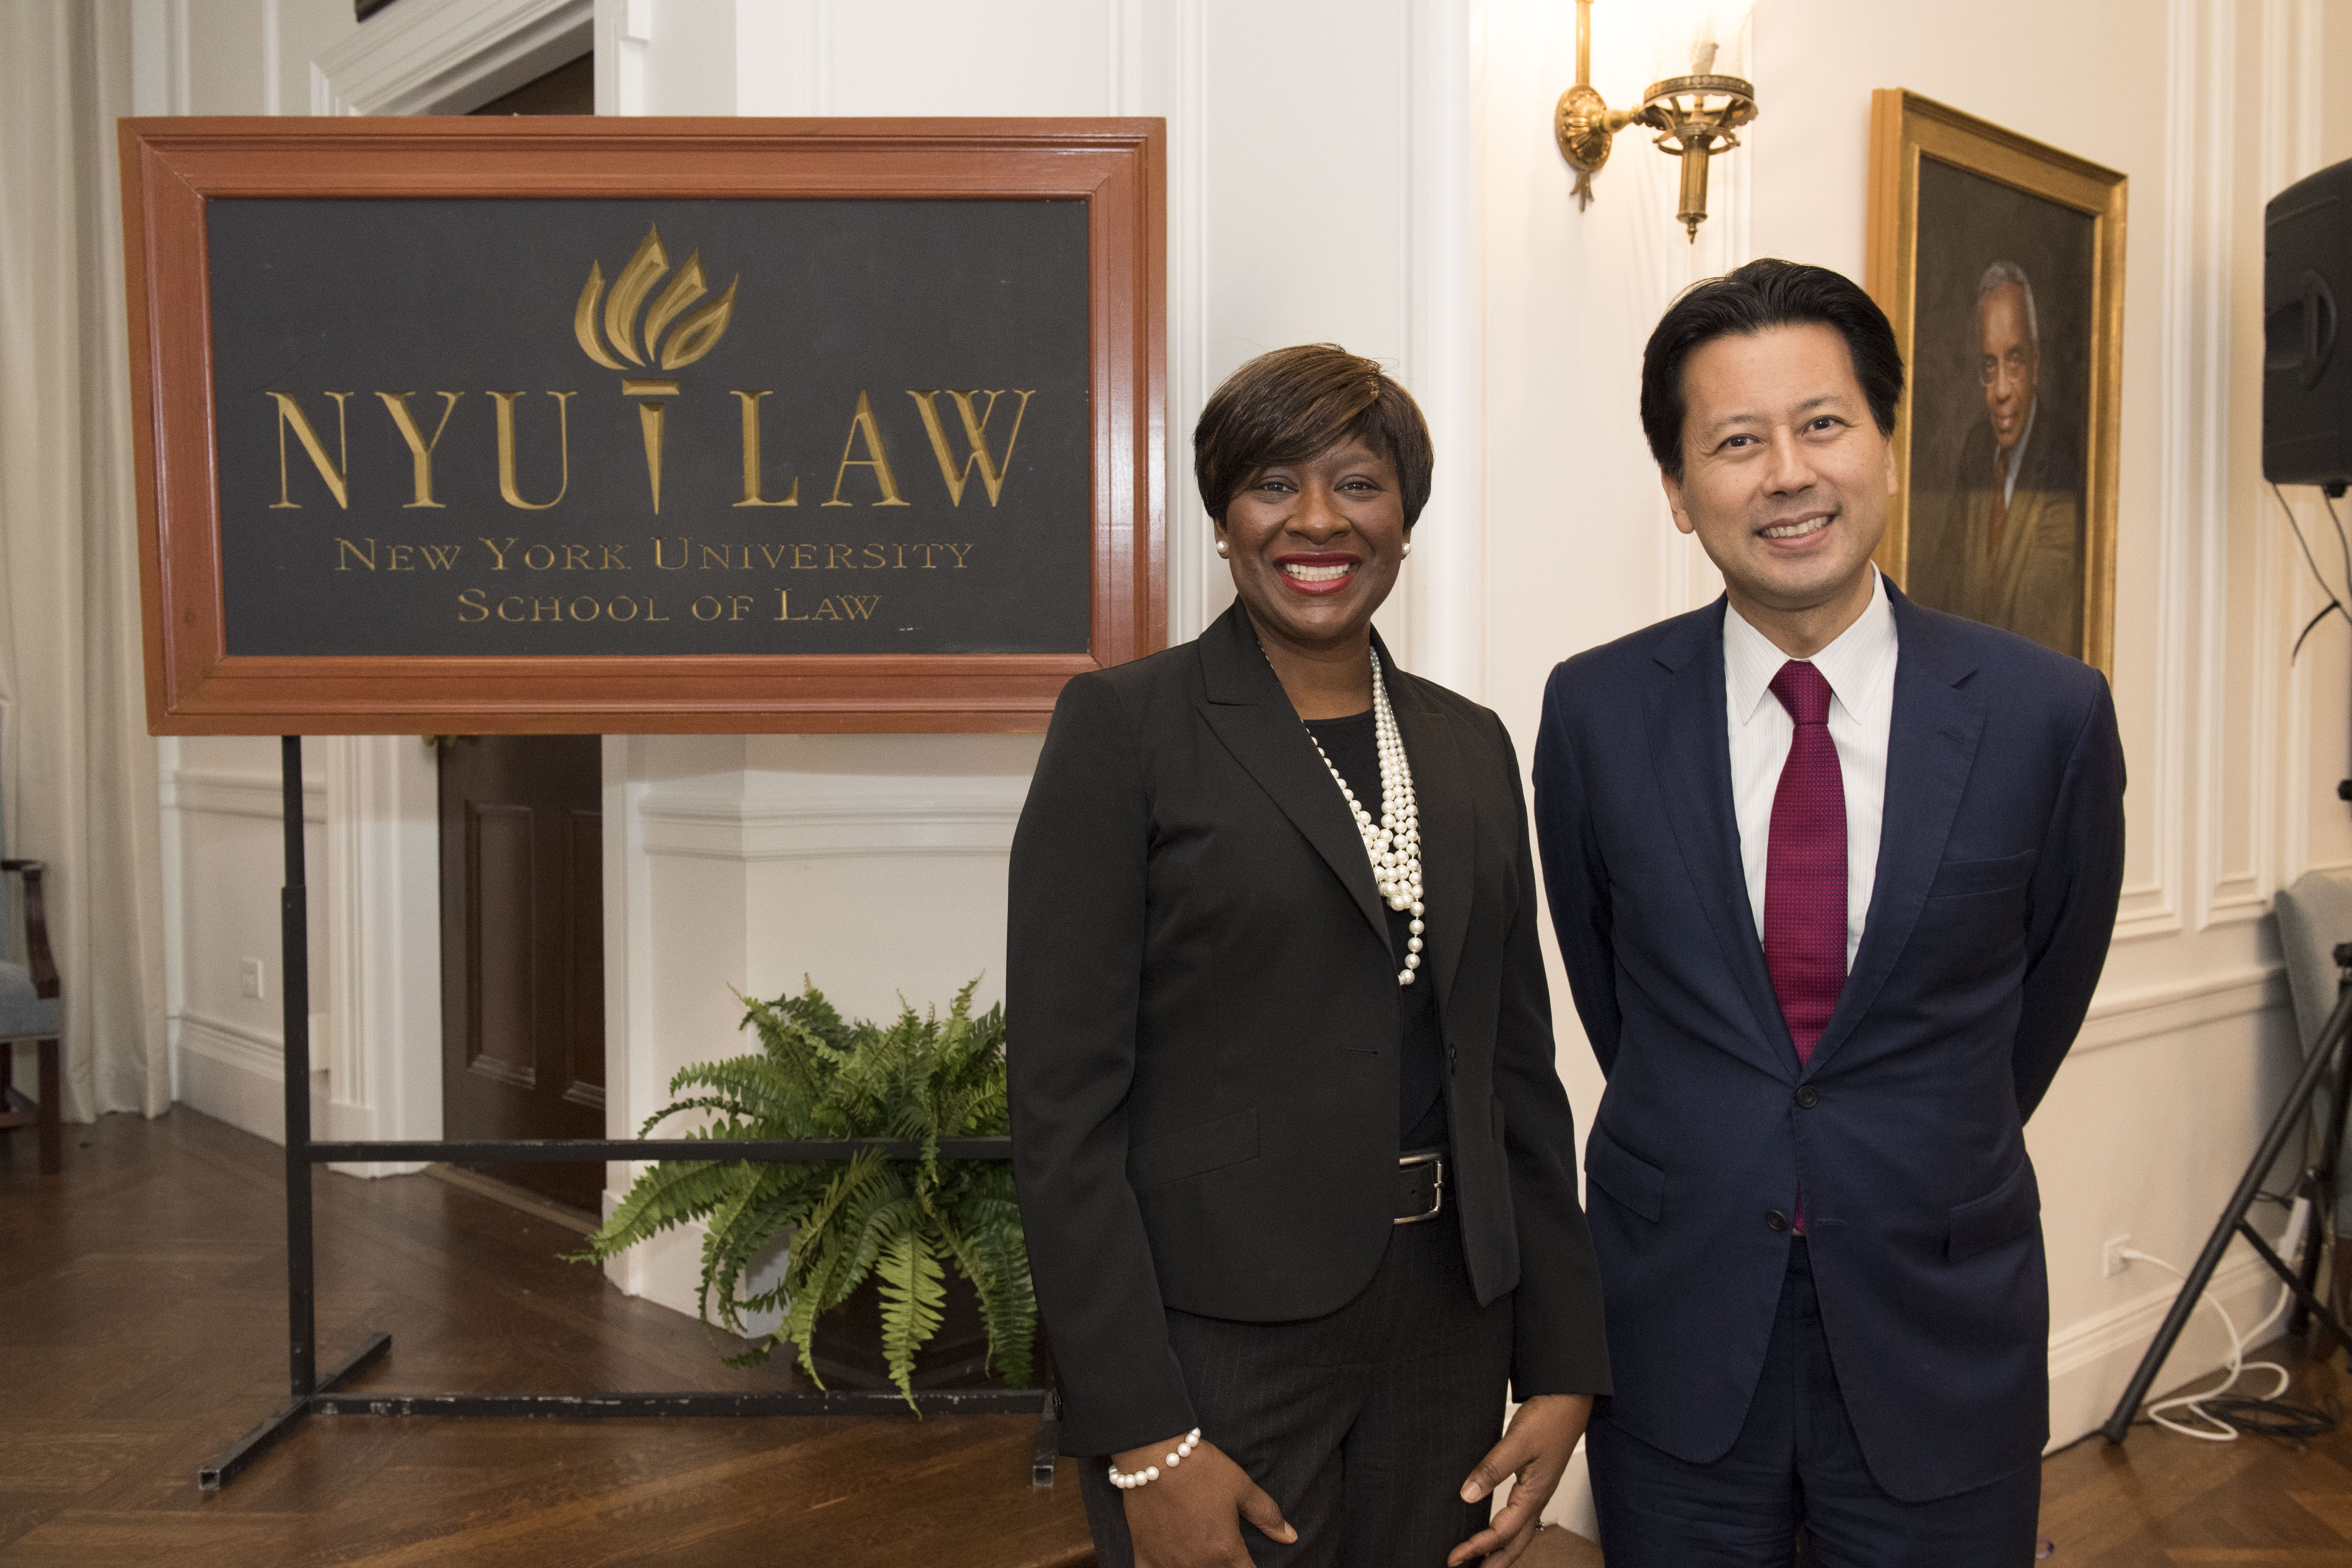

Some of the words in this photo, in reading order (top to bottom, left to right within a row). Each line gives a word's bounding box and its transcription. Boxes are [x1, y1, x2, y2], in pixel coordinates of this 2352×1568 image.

[266, 390, 578, 510] NYU
[729, 389, 1036, 507] LAW
[334, 538, 461, 571] NEW
[479, 537, 632, 571] YORK
[650, 536, 974, 570] UNIVERSITY
[457, 588, 669, 622] SCHOOL
[773, 588, 882, 622] LAW
